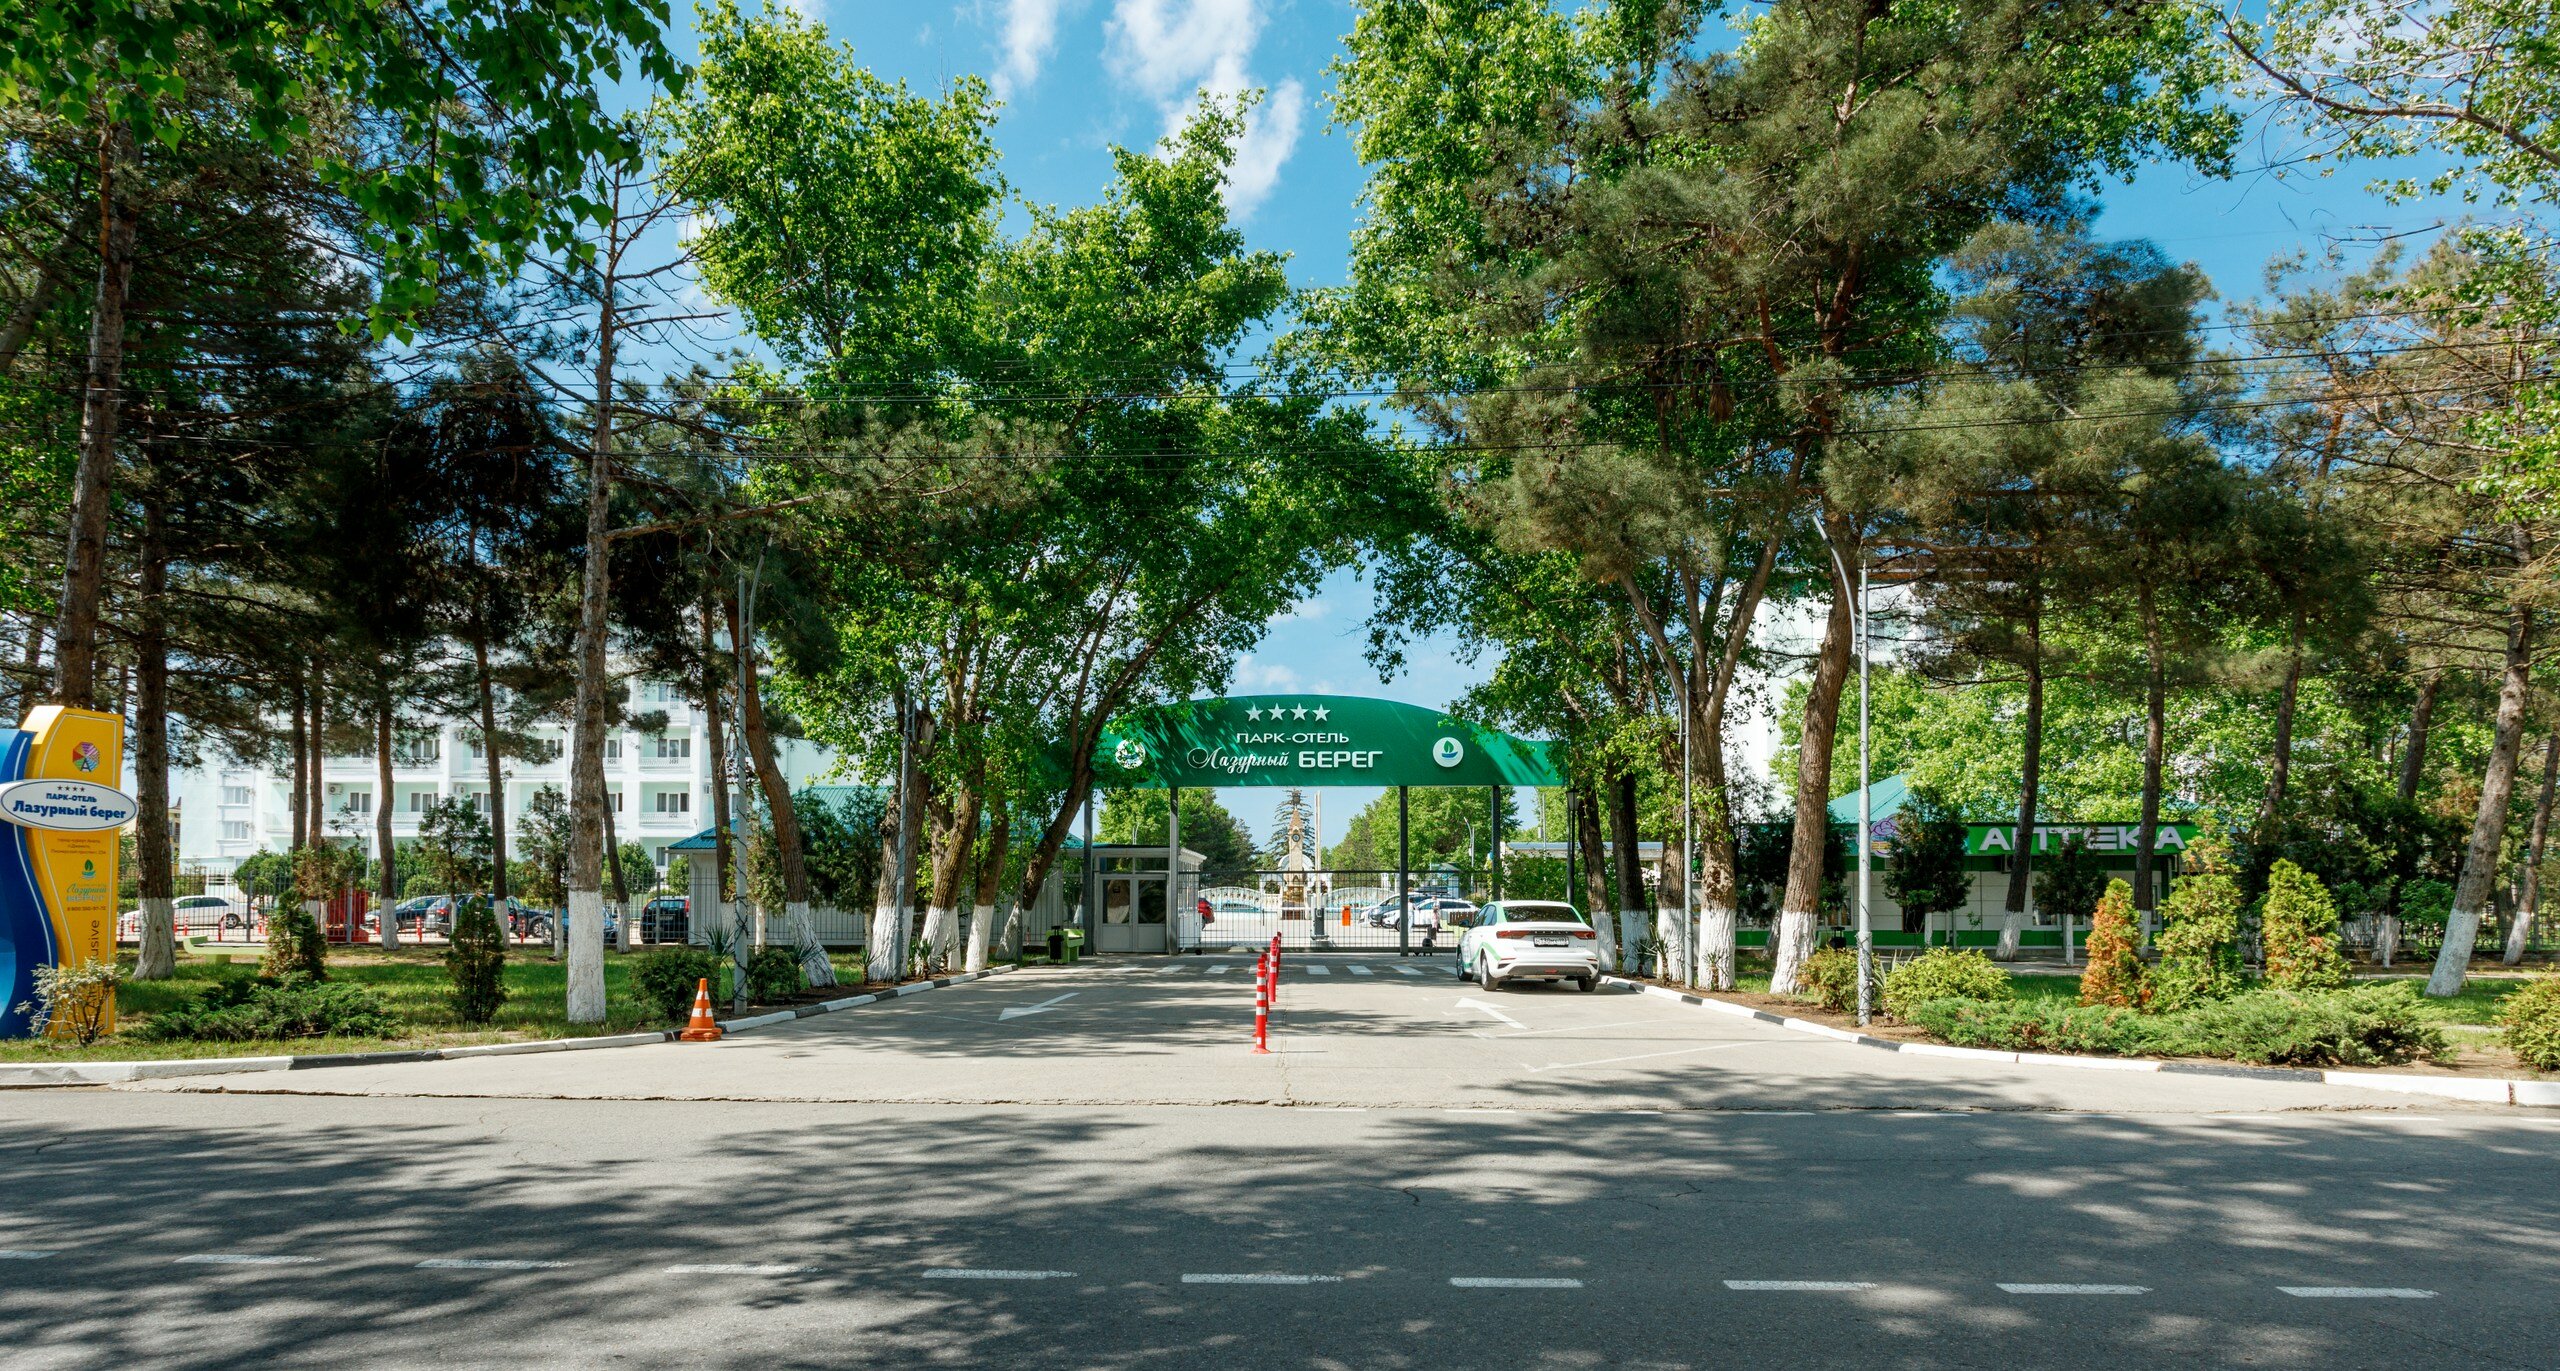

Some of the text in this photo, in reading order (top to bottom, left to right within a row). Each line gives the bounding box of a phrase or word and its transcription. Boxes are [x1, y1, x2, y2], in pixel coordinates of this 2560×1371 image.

[1236, 733, 1349, 744] ПАРК-ОТЕЛЬ
[1187, 747, 1383, 774] Лазурный БЕРЕГ
[46, 793, 97, 803] ПАРК-ОТЕЛЬ
[13, 800, 126, 820] Лазурный берег
